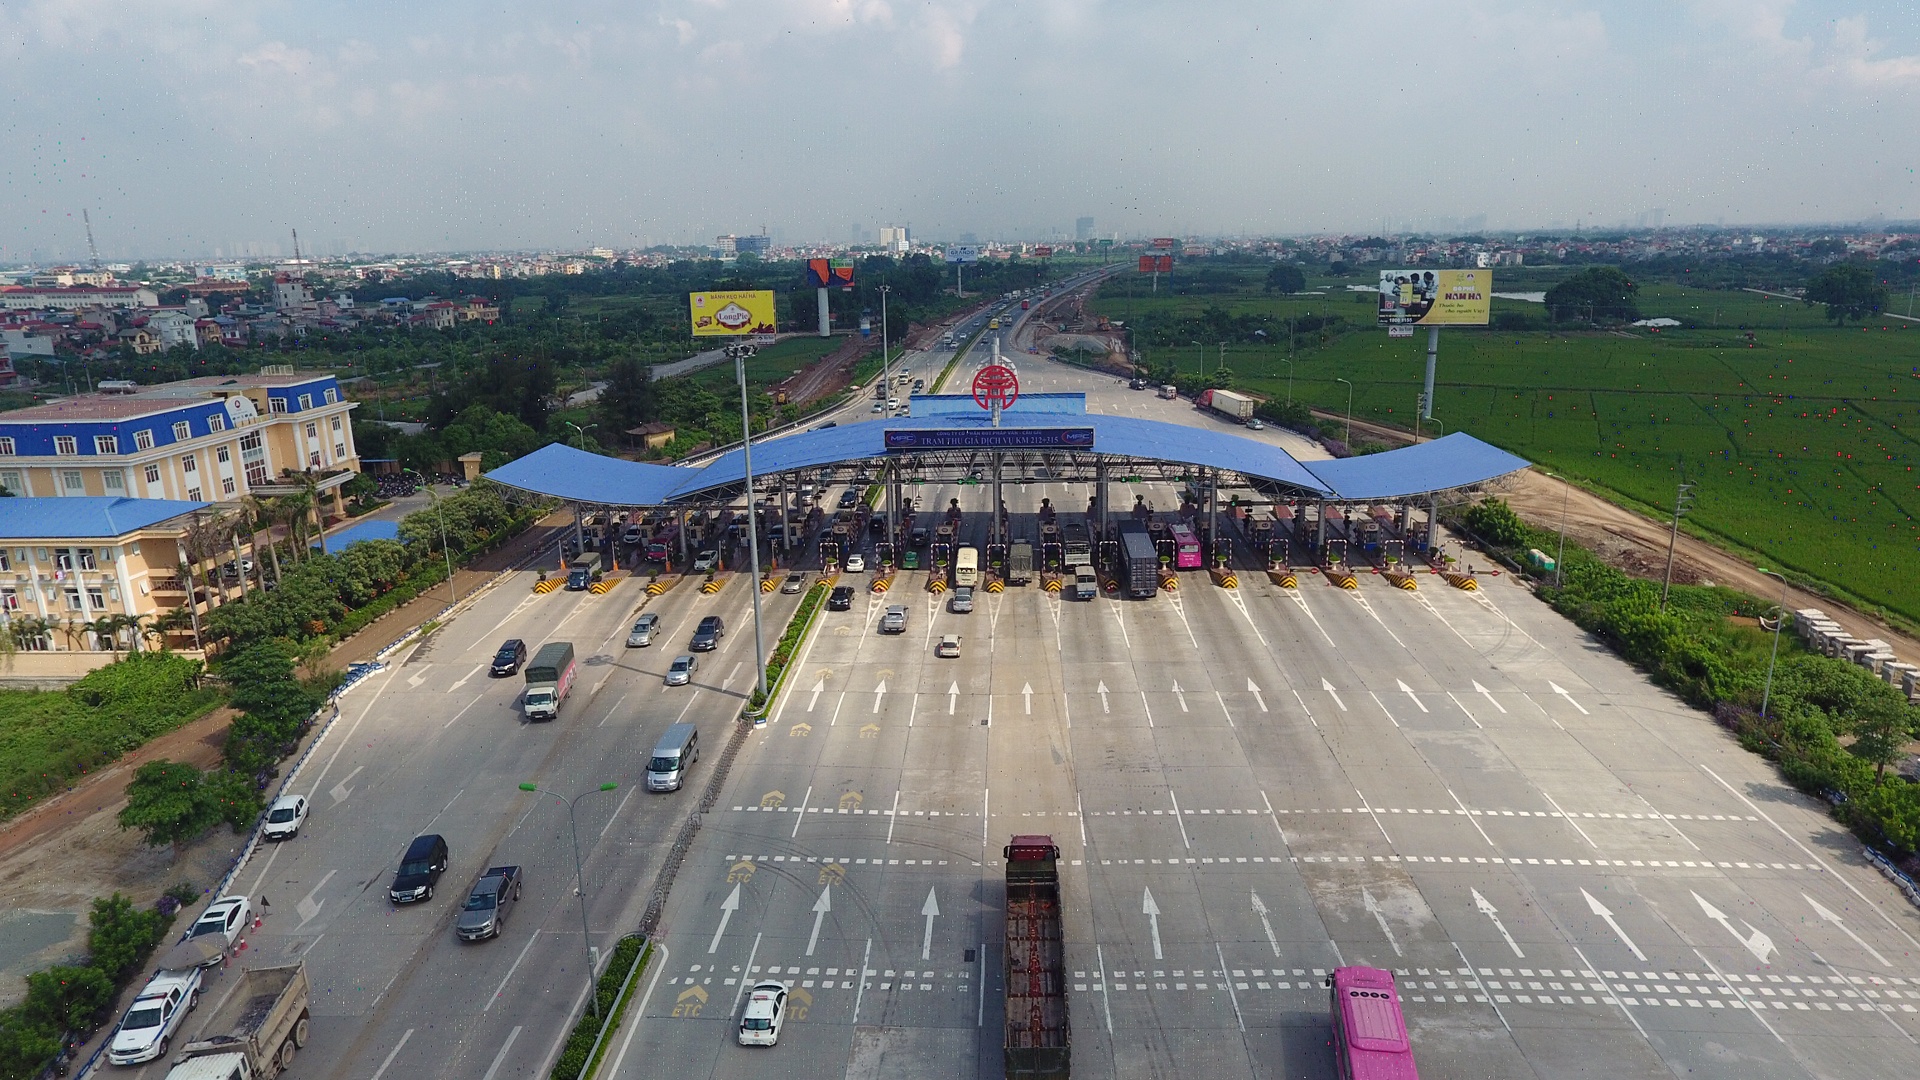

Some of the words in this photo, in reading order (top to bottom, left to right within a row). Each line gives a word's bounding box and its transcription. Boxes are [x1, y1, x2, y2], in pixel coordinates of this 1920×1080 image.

[719, 312, 748, 321] LongPie
[921, 438, 944, 446] TRẠM
[981, 437, 1001, 445] DỊCH
[1002, 437, 1014, 445] VỤ
[760, 799, 782, 808] ETC
[839, 801, 861, 809] ETC
[727, 873, 752, 883] ETC
[818, 875, 843, 885] ETC
[672, 1004, 702, 1018] ETC
